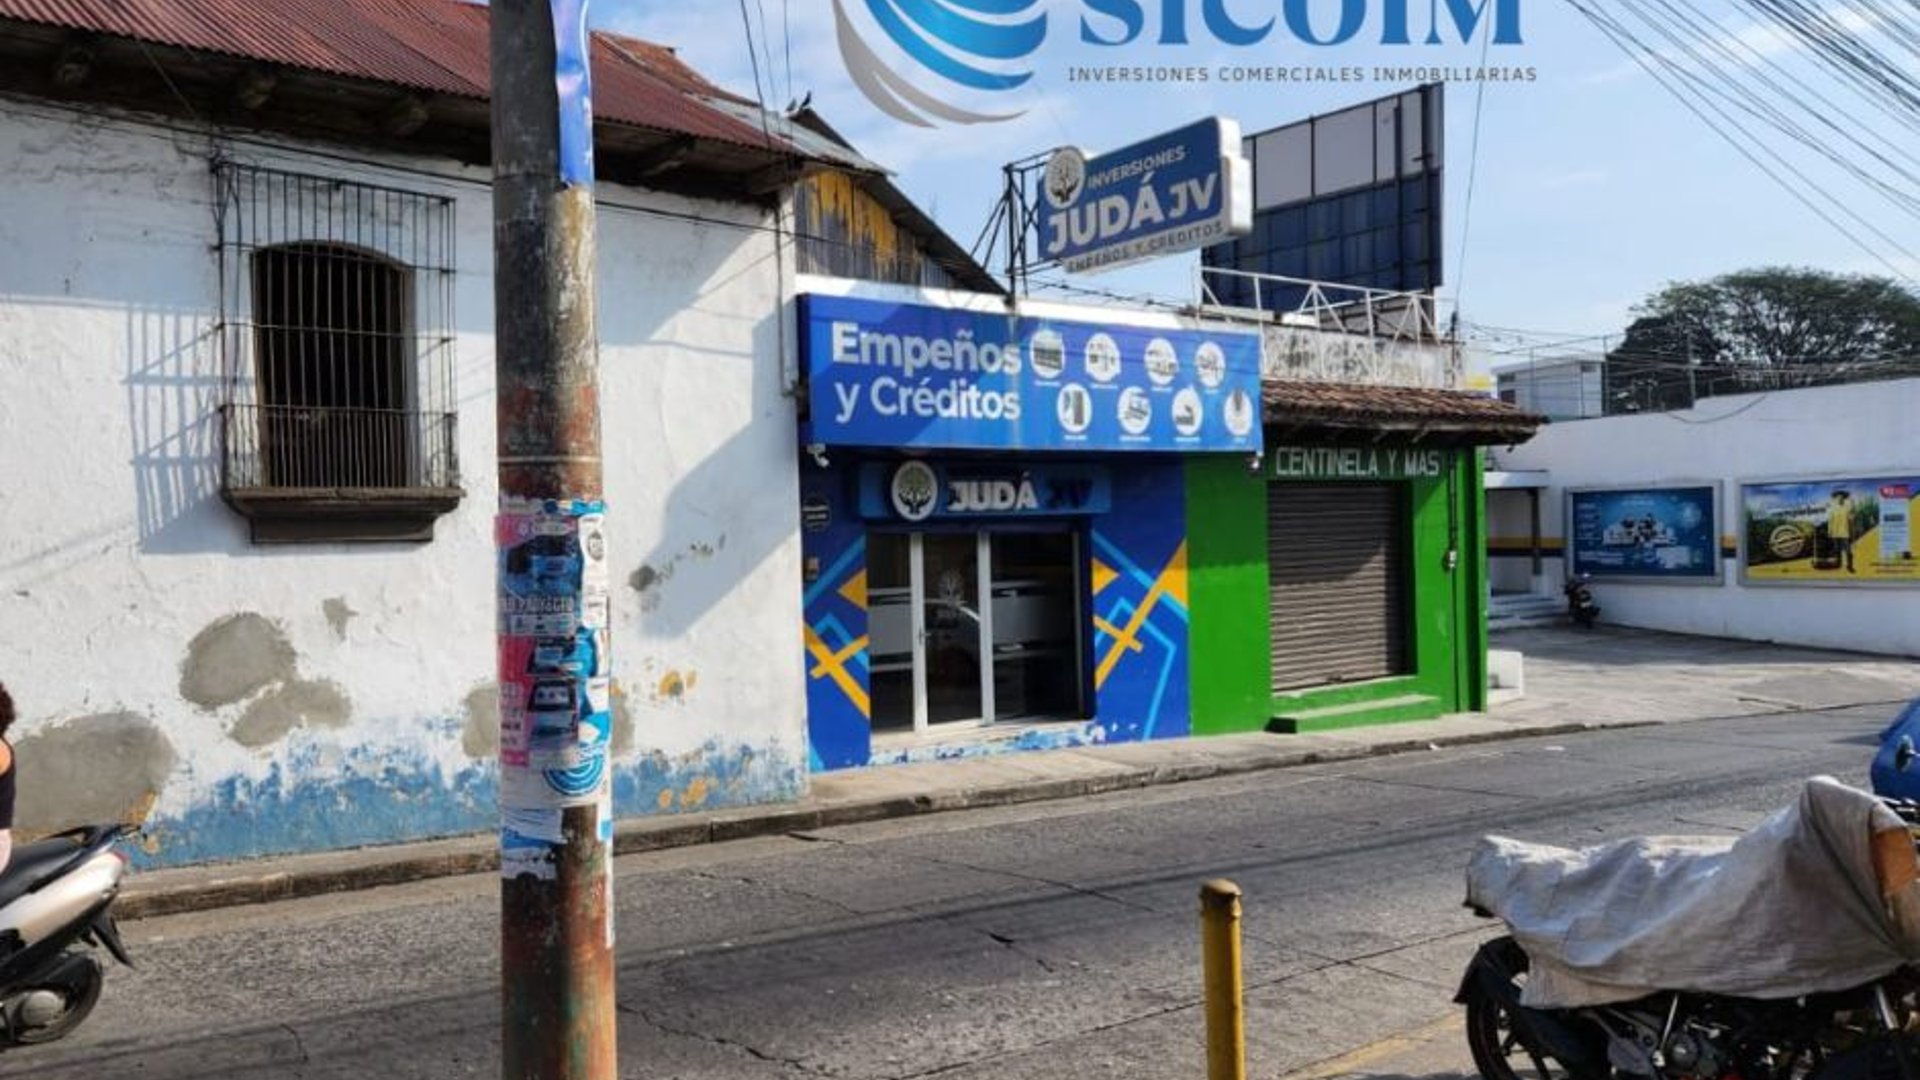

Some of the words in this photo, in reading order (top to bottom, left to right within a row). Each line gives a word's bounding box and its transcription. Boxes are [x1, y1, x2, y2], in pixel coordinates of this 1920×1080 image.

[1087, 145, 1186, 189] INVERSIONES
[1047, 172, 1165, 254] JUDÁ
[1169, 173, 1218, 218] JV
[832, 321, 1022, 377] Empeños
[834, 382, 861, 424] y
[870, 376, 1021, 420] Créditos
[1276, 447, 1379, 476] CENTINELA
[1386, 450, 1396, 476] Y
[1404, 451, 1440, 476] MAS
[947, 471, 1039, 512] JUDÁ
